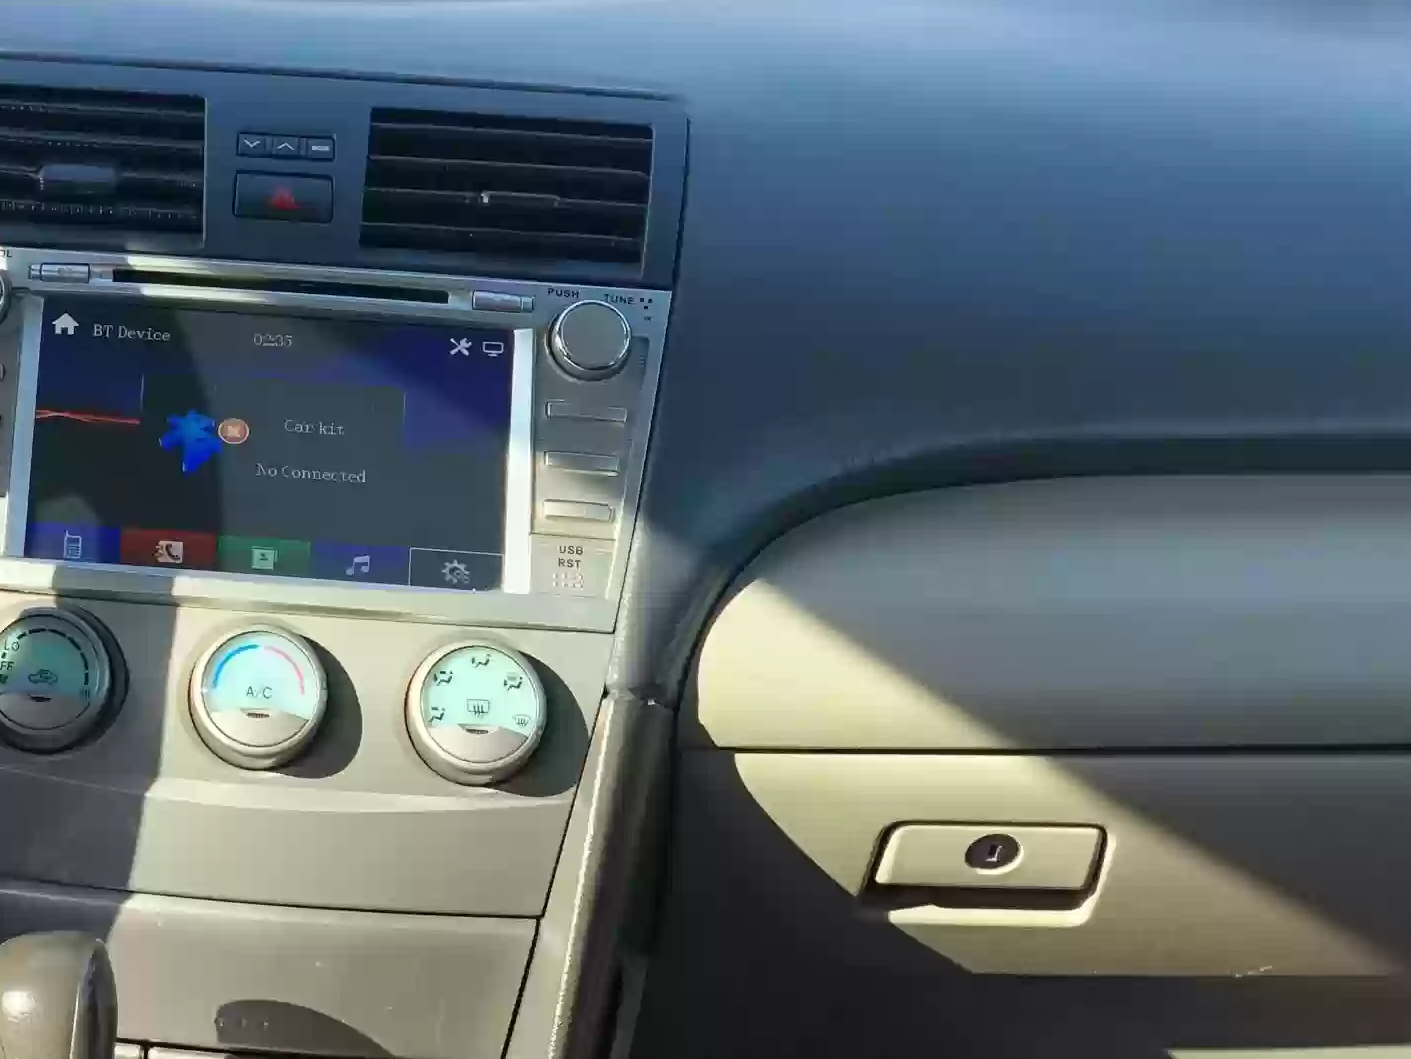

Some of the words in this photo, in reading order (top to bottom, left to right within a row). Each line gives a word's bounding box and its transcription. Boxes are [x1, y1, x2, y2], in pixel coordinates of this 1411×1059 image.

[548, 287, 580, 299] PUSH
[604, 293, 635, 305] TUNE
[93, 323, 114, 338] BT
[118, 325, 171, 342] Device
[284, 419, 316, 434] Car
[319, 421, 345, 436] kit
[255, 463, 278, 478] No
[282, 465, 367, 484] Connected
[559, 545, 584, 556] USB
[558, 558, 581, 569] RST
